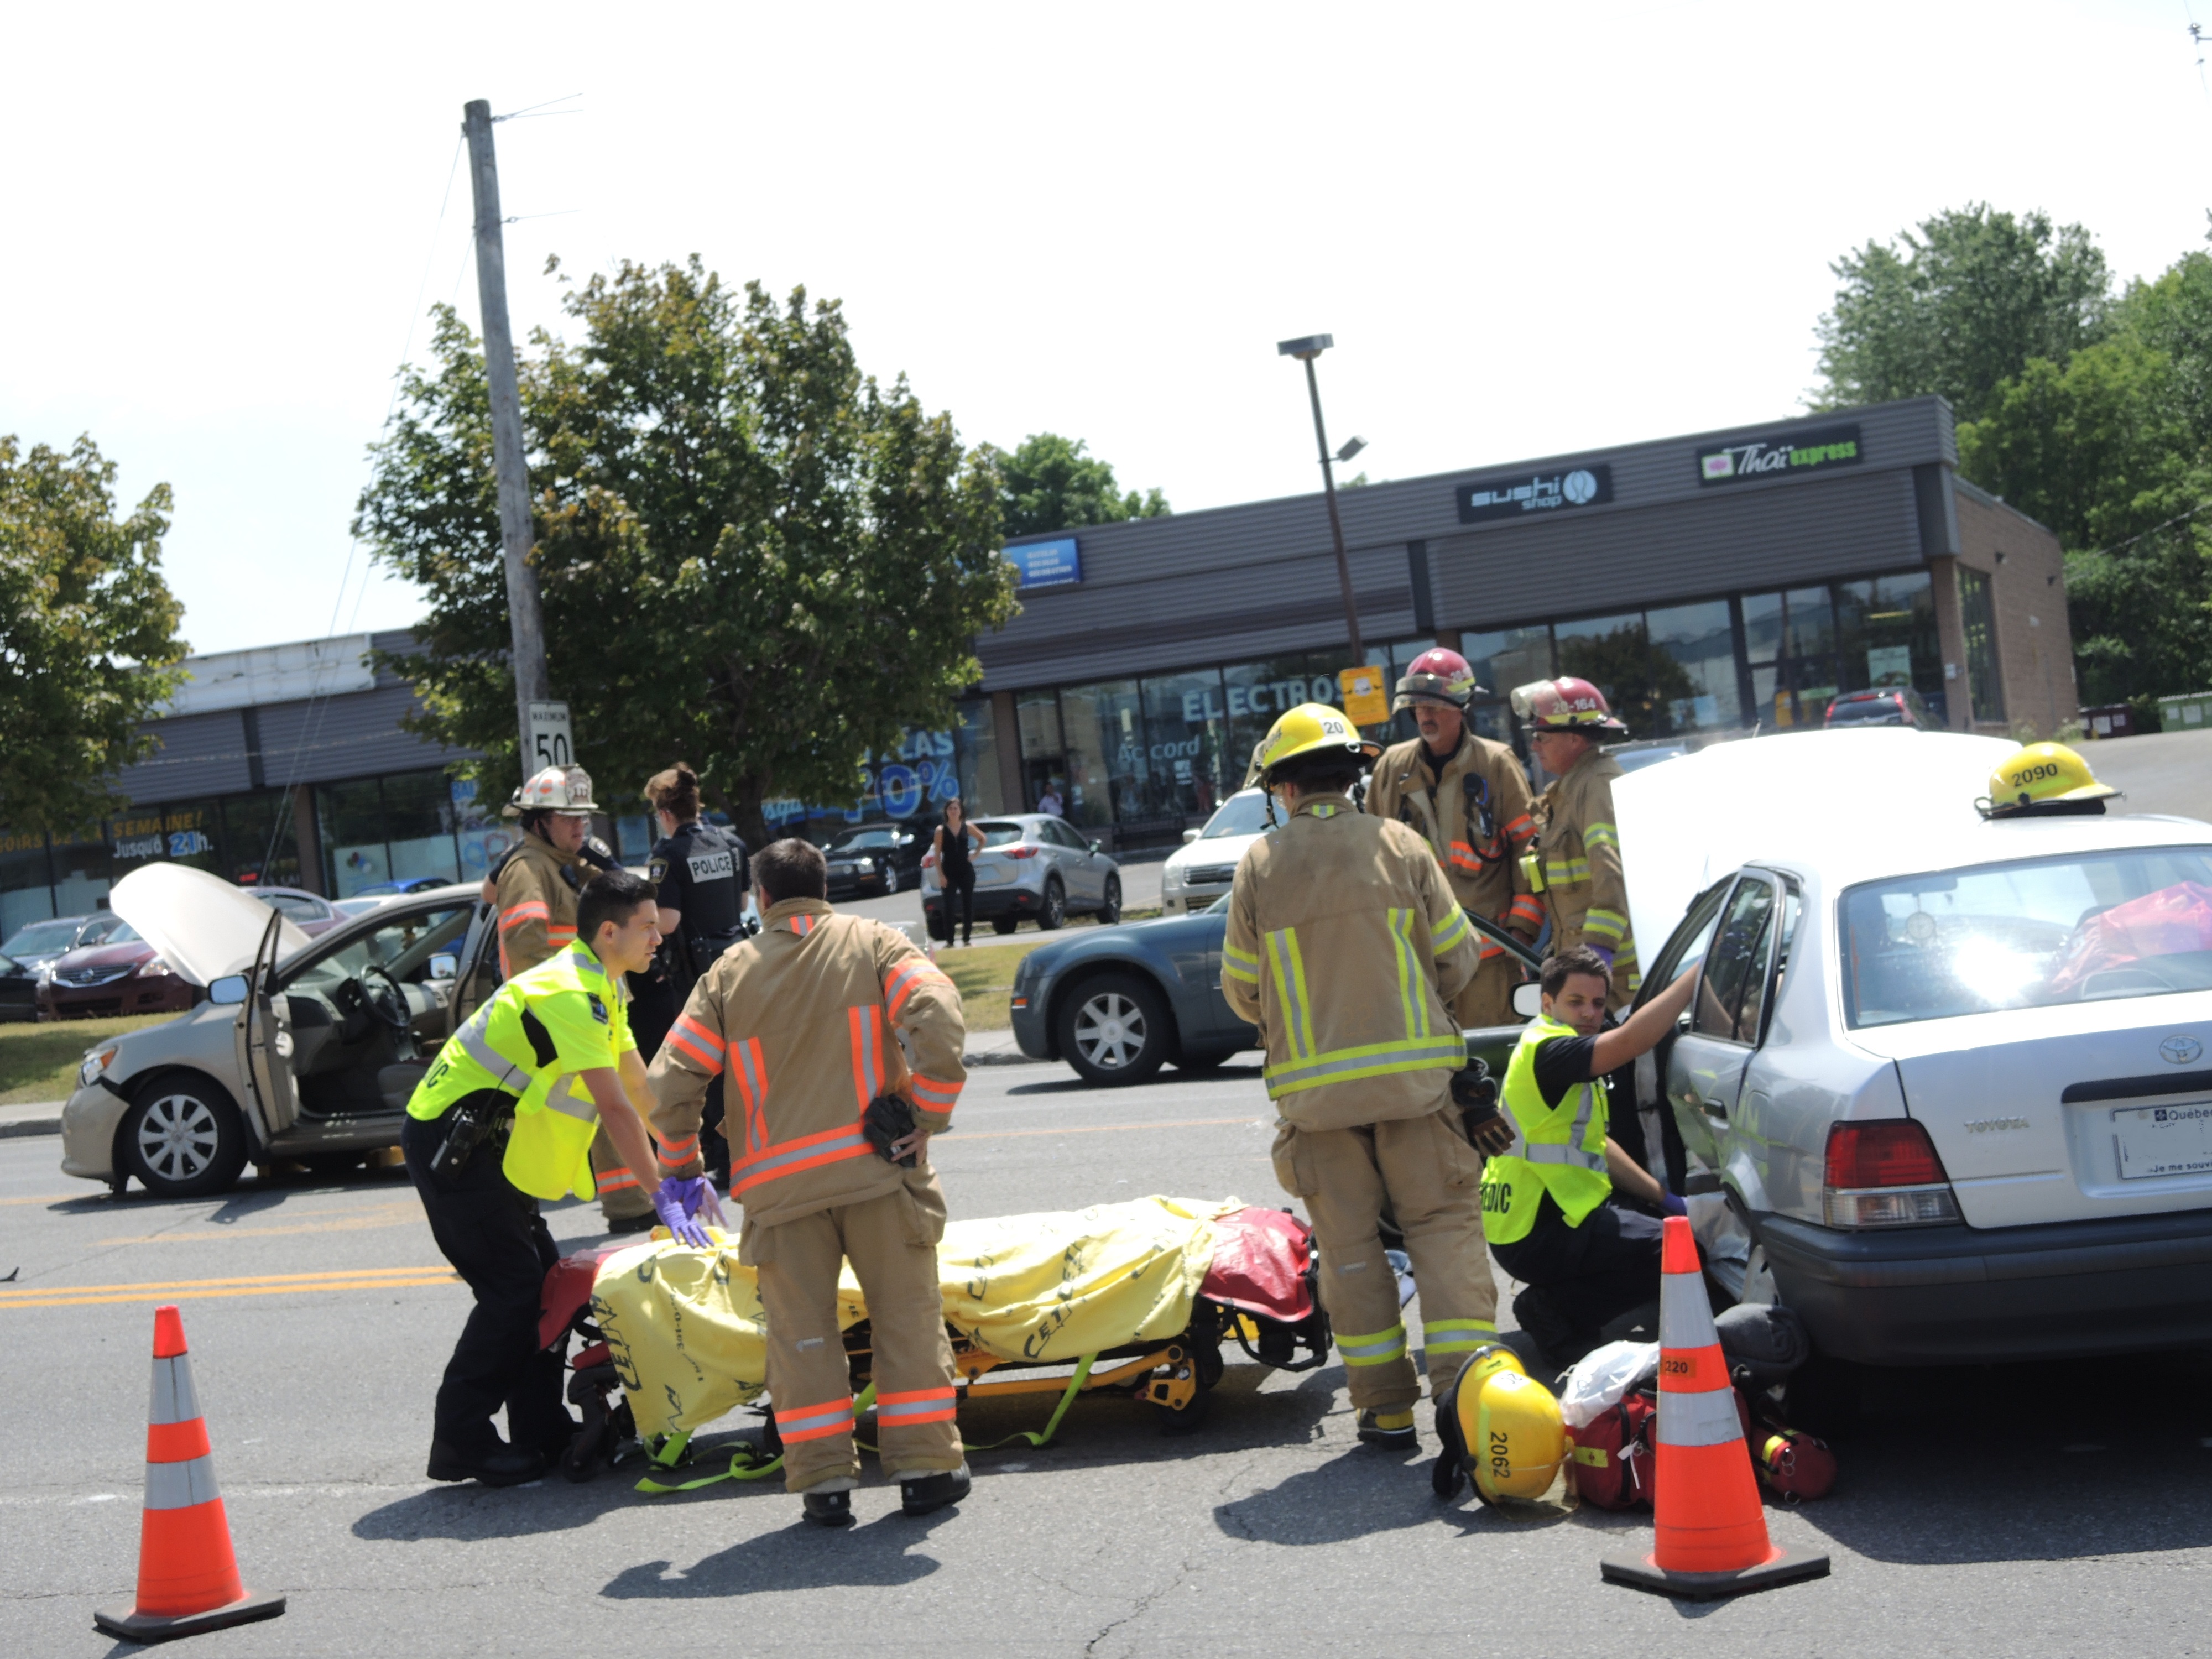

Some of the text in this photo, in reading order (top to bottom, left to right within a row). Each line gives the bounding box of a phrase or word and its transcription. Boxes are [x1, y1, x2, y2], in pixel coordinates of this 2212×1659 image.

[1521, 495, 1562, 510] shop
[1552, 698, 1596, 714] 20-164
[1323, 721, 1344, 734] 20
[536, 733, 568, 766] 50
[2012, 763, 2058, 788] 2090
[692, 856, 732, 877] POLICE
[1964, 1116, 2030, 1133] TOYOTA
[2168, 1163, 2183, 1171] me
[1490, 1431, 1511, 1479] 2062
